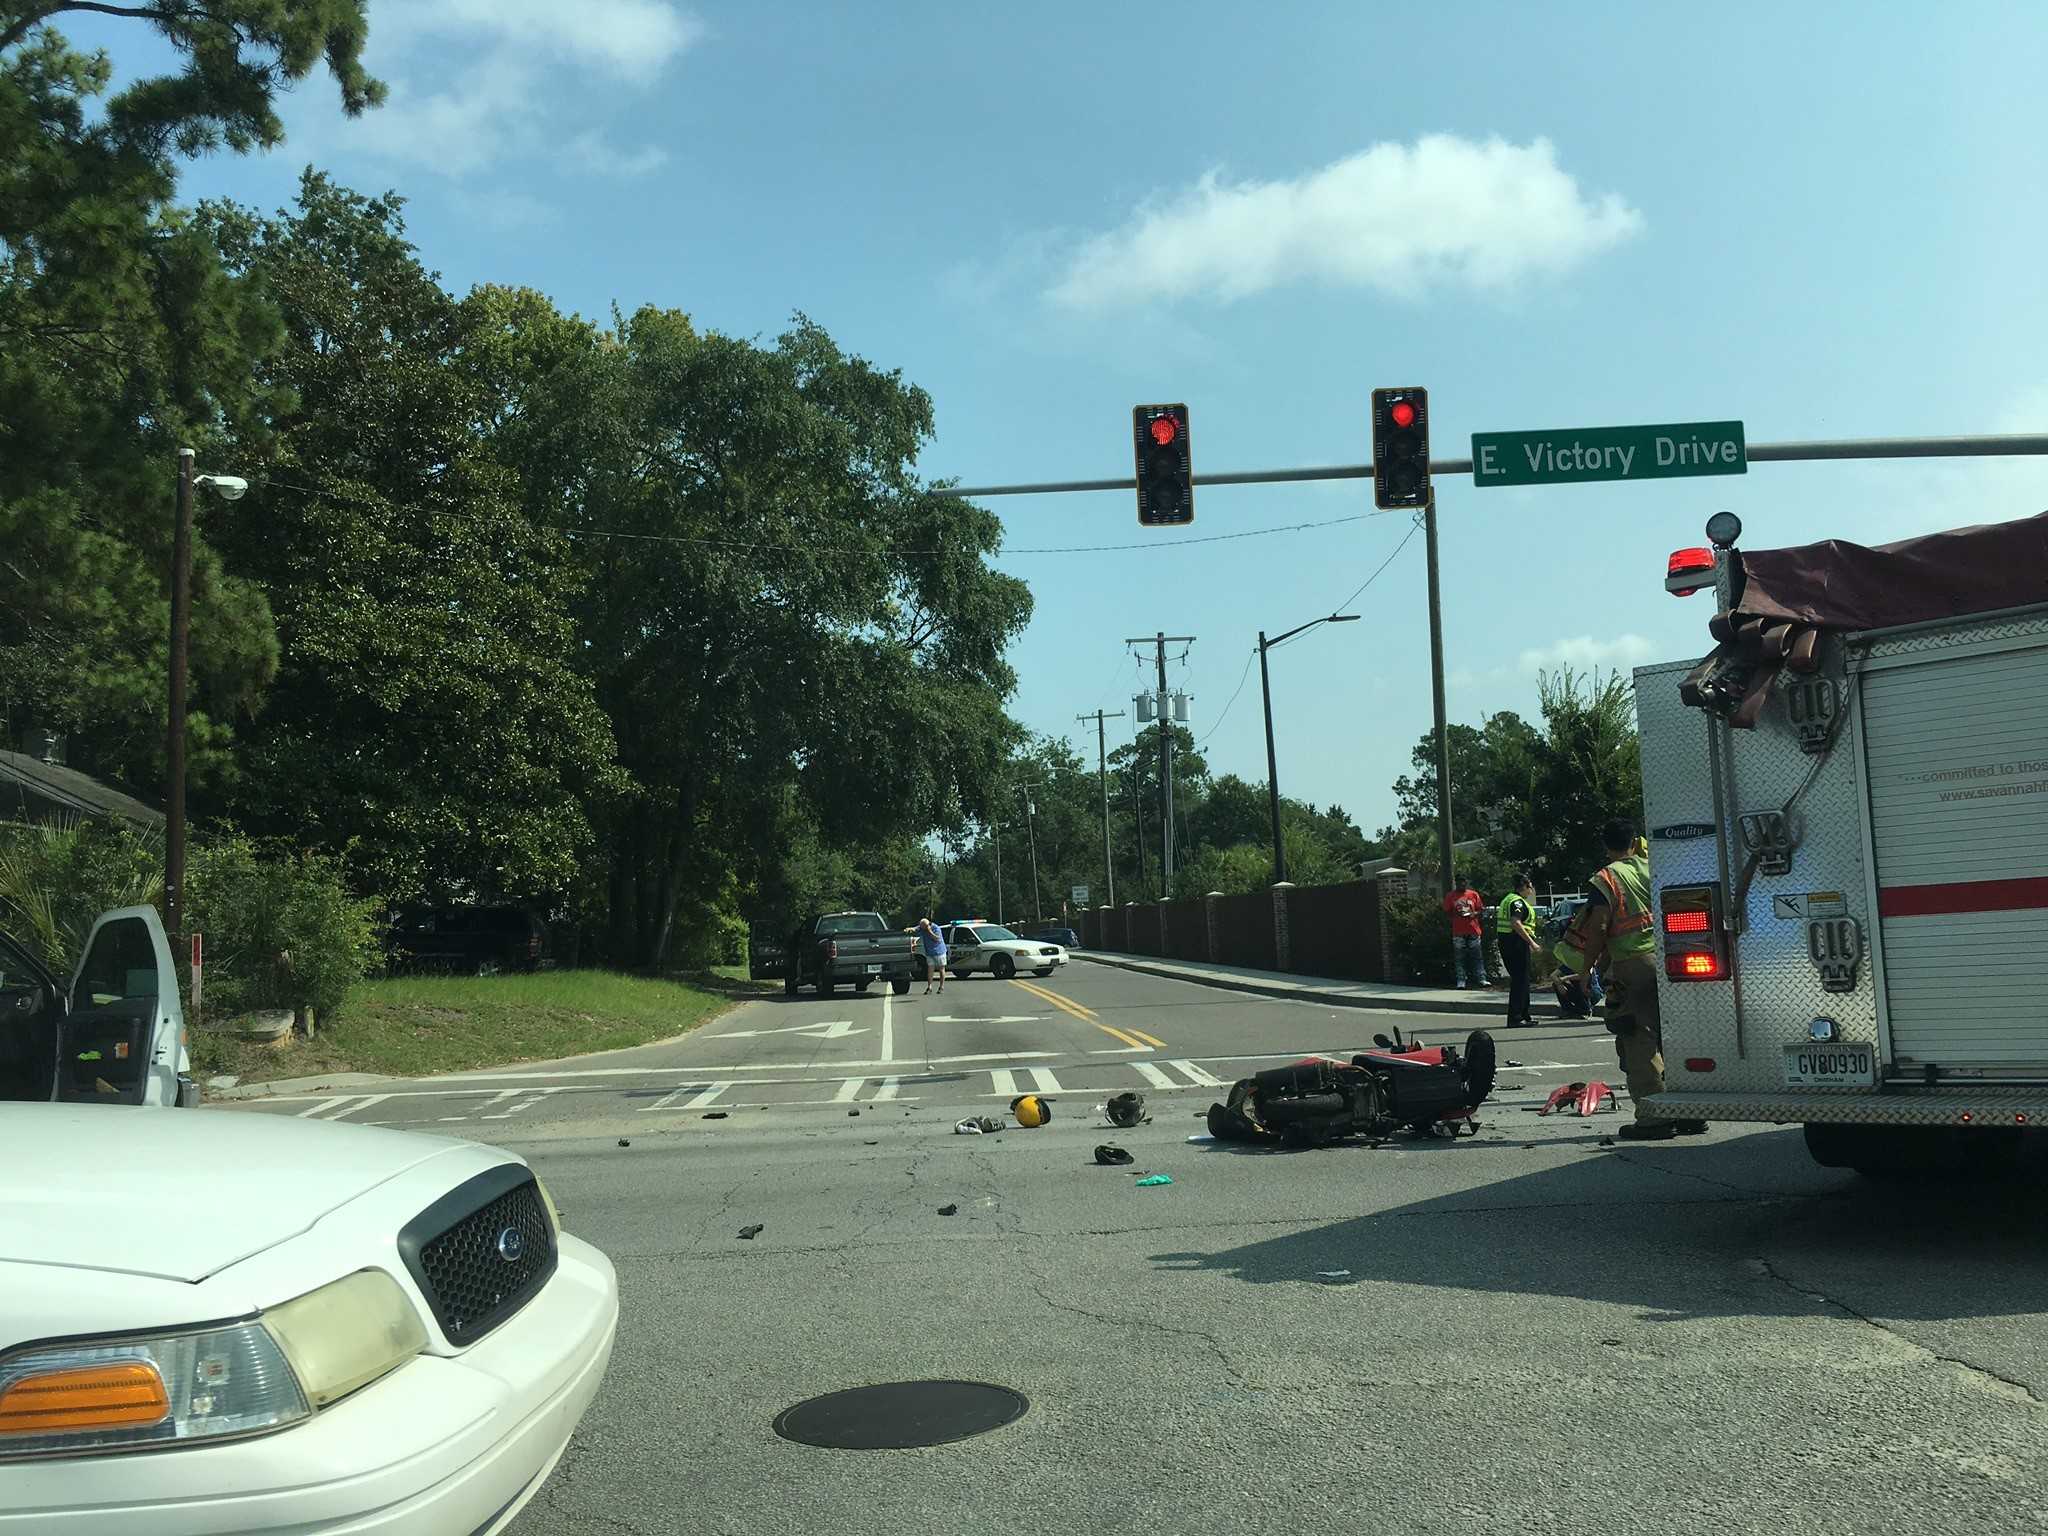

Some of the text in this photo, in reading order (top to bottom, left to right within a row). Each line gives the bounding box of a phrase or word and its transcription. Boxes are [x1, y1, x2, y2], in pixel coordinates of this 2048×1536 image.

[1480, 435, 1738, 476] E. Victory Drive
[1999, 763, 2014, 776] to
[1665, 825, 1703, 839] Quality
[1799, 1053, 1868, 1075] GV80930
